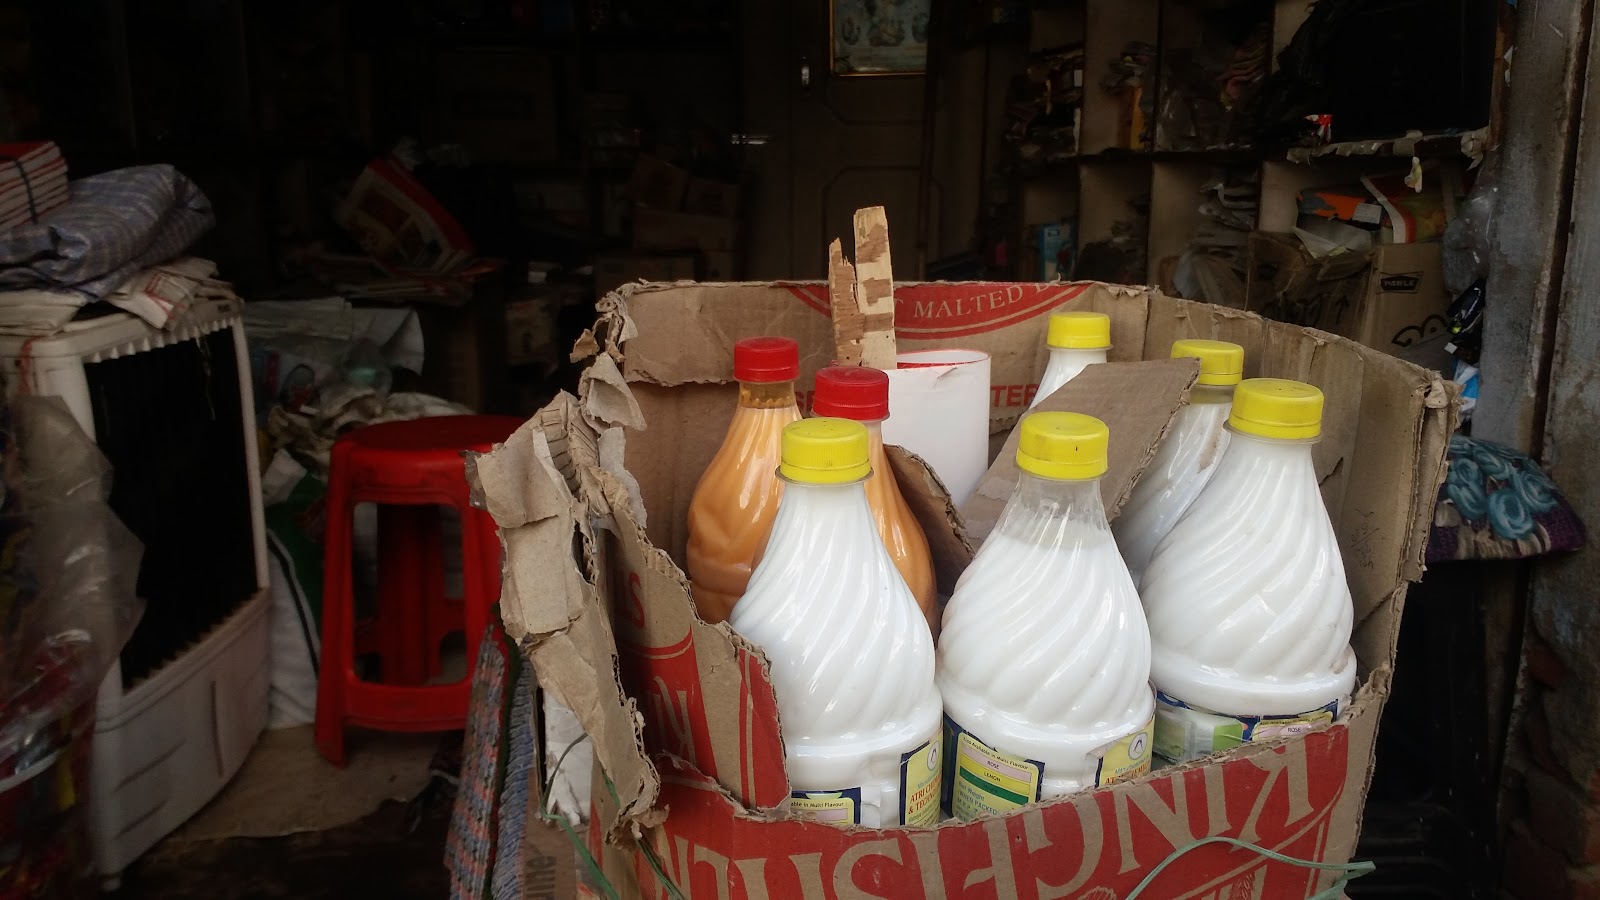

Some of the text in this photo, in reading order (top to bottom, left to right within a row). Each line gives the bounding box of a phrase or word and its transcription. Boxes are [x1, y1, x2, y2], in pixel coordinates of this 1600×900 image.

[912, 283, 1024, 319] MALTED
[986, 760, 1000, 770] ROSE
[1009, 760, 1030, 770] Flavour
[983, 771, 1002, 783] LEMON
[909, 787, 926, 804] ATRI
[967, 786, 985, 801] Weight
[908, 804, 915, 815] &
